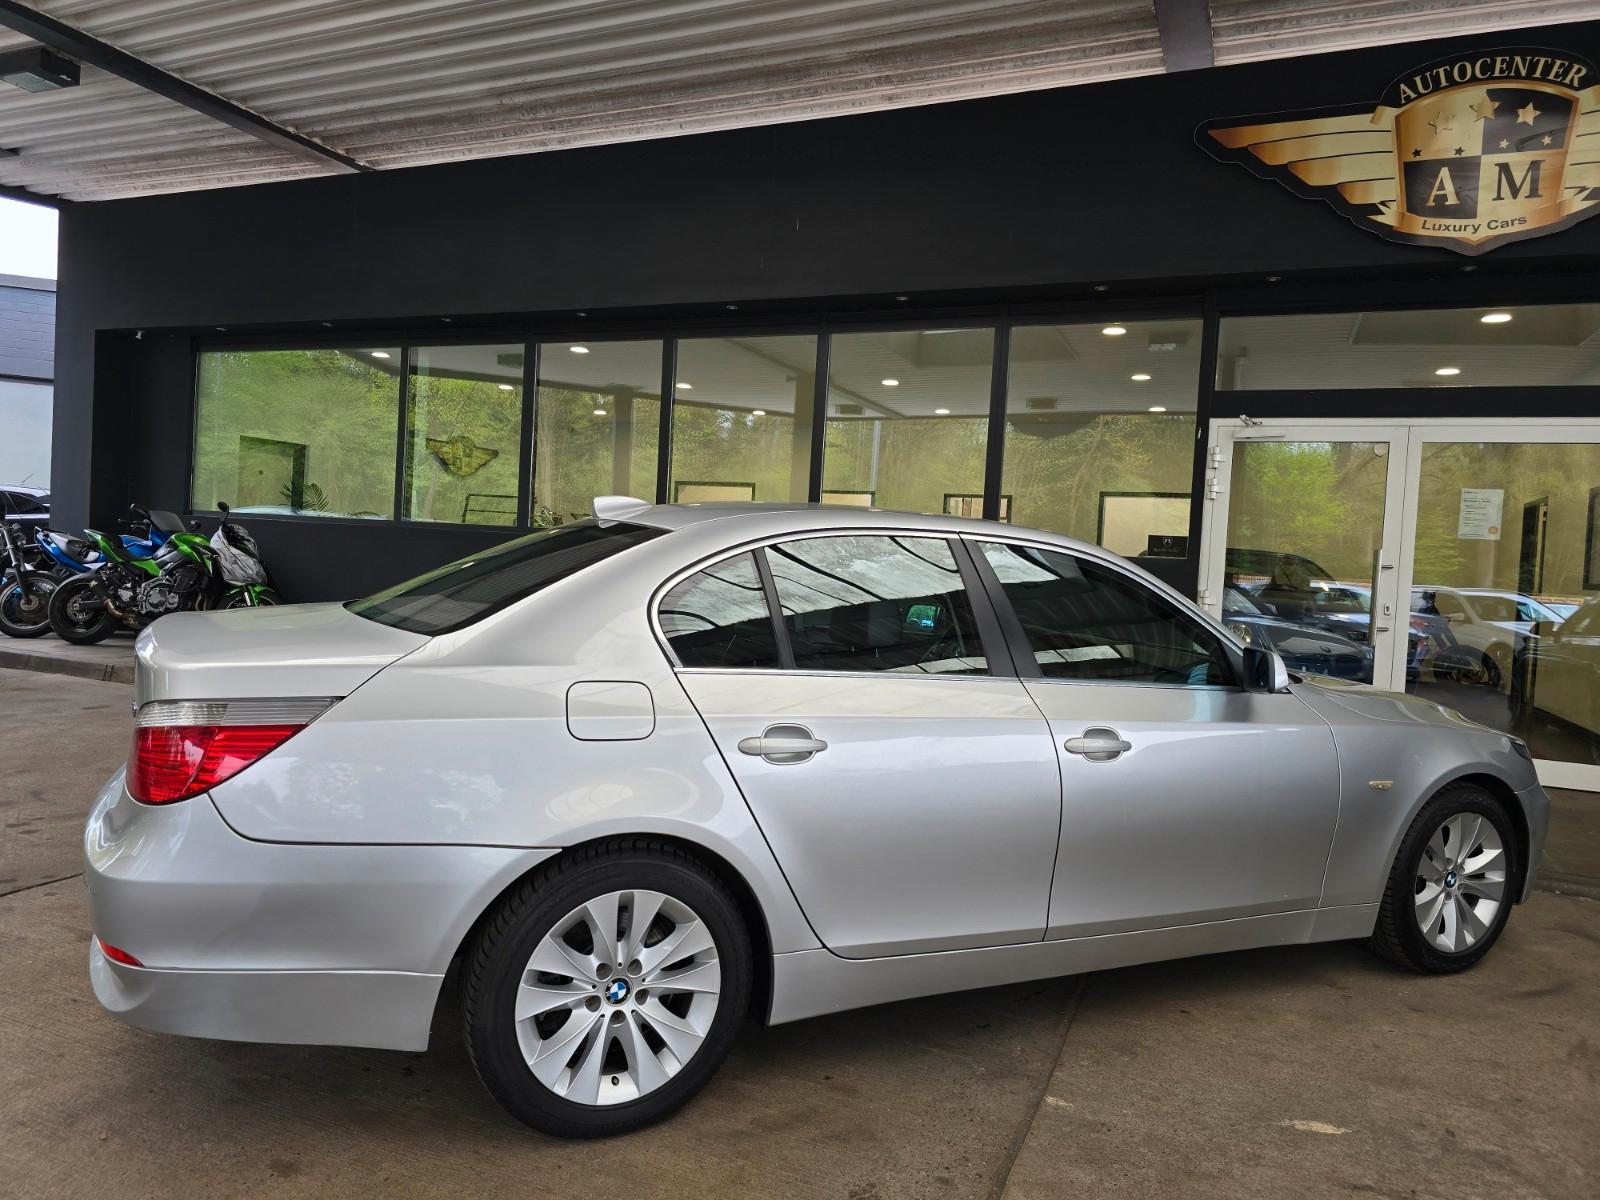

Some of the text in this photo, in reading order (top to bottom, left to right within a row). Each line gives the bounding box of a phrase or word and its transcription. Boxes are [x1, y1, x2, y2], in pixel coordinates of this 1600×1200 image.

[1400, 55, 1587, 104] AUTOCENTER
[1425, 159, 1546, 207] A M
[1421, 216, 1528, 235] Luxury Cars
